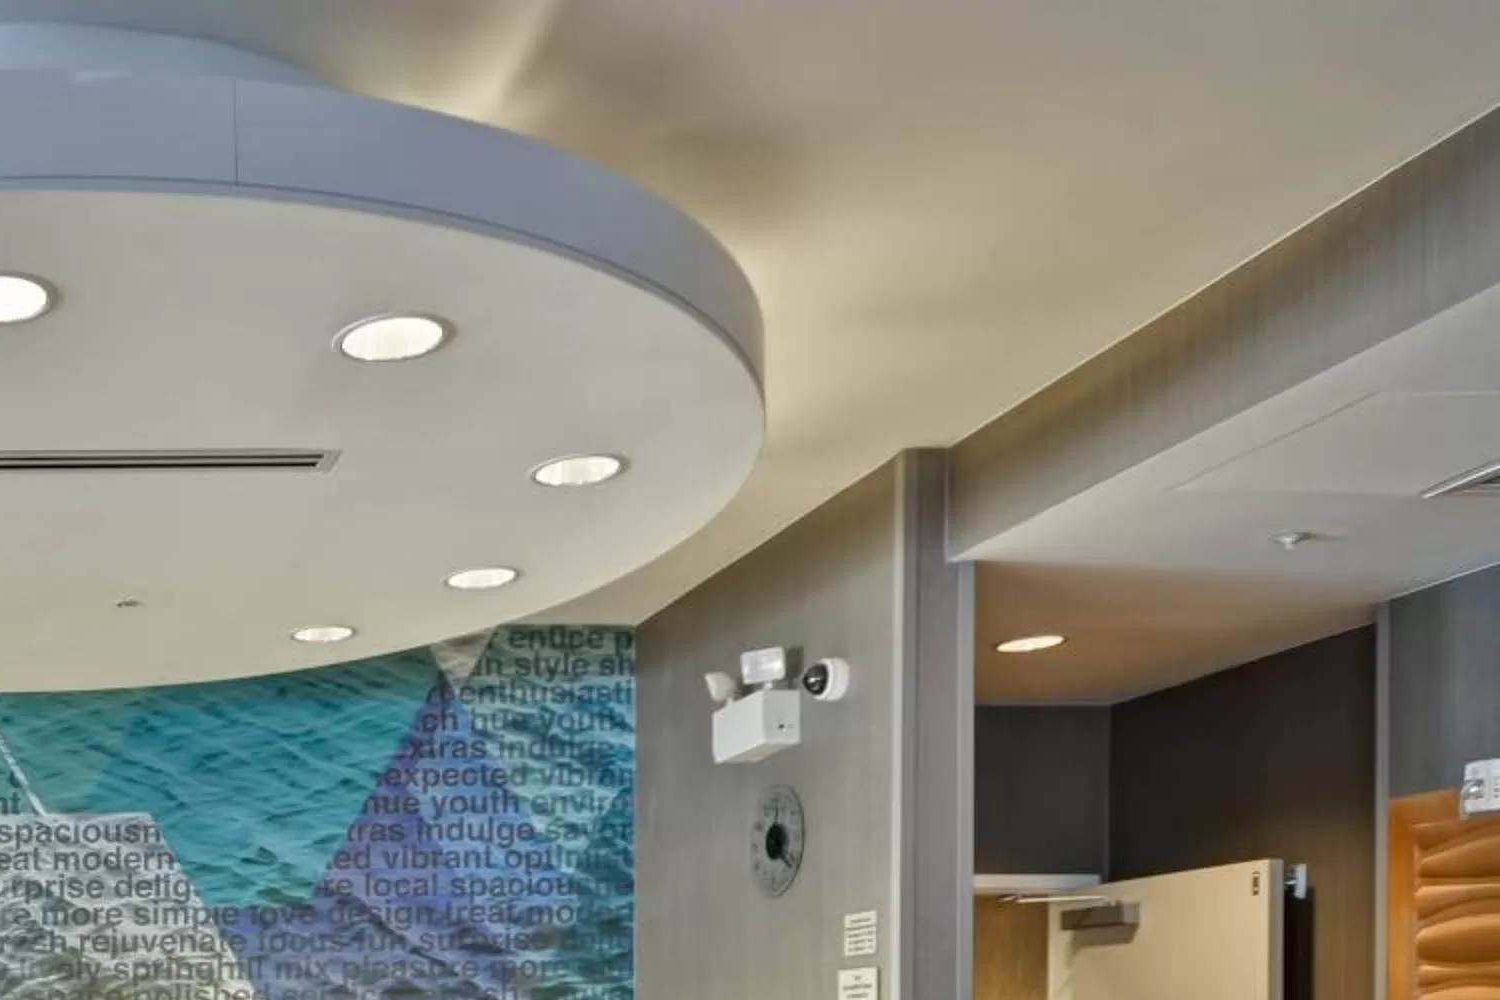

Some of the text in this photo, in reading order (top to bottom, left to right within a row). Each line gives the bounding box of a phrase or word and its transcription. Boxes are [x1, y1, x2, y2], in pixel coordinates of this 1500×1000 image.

[509, 626, 603, 650] entice
[516, 652, 587, 682] style
[433, 790, 519, 820] youth
[417, 818, 535, 848] indulge
[53, 845, 175, 869] modern
[383, 845, 492, 869] vibrant
[364, 873, 437, 897] local
[42, 908, 123, 926] more
[133, 901, 238, 931] simple
[251, 901, 314, 925] love
[327, 901, 432, 931] design
[444, 902, 518, 924] treat
[79, 929, 246, 959] rejuvenate
[258, 928, 341, 952] focus
[114, 956, 265, 986] springhill
